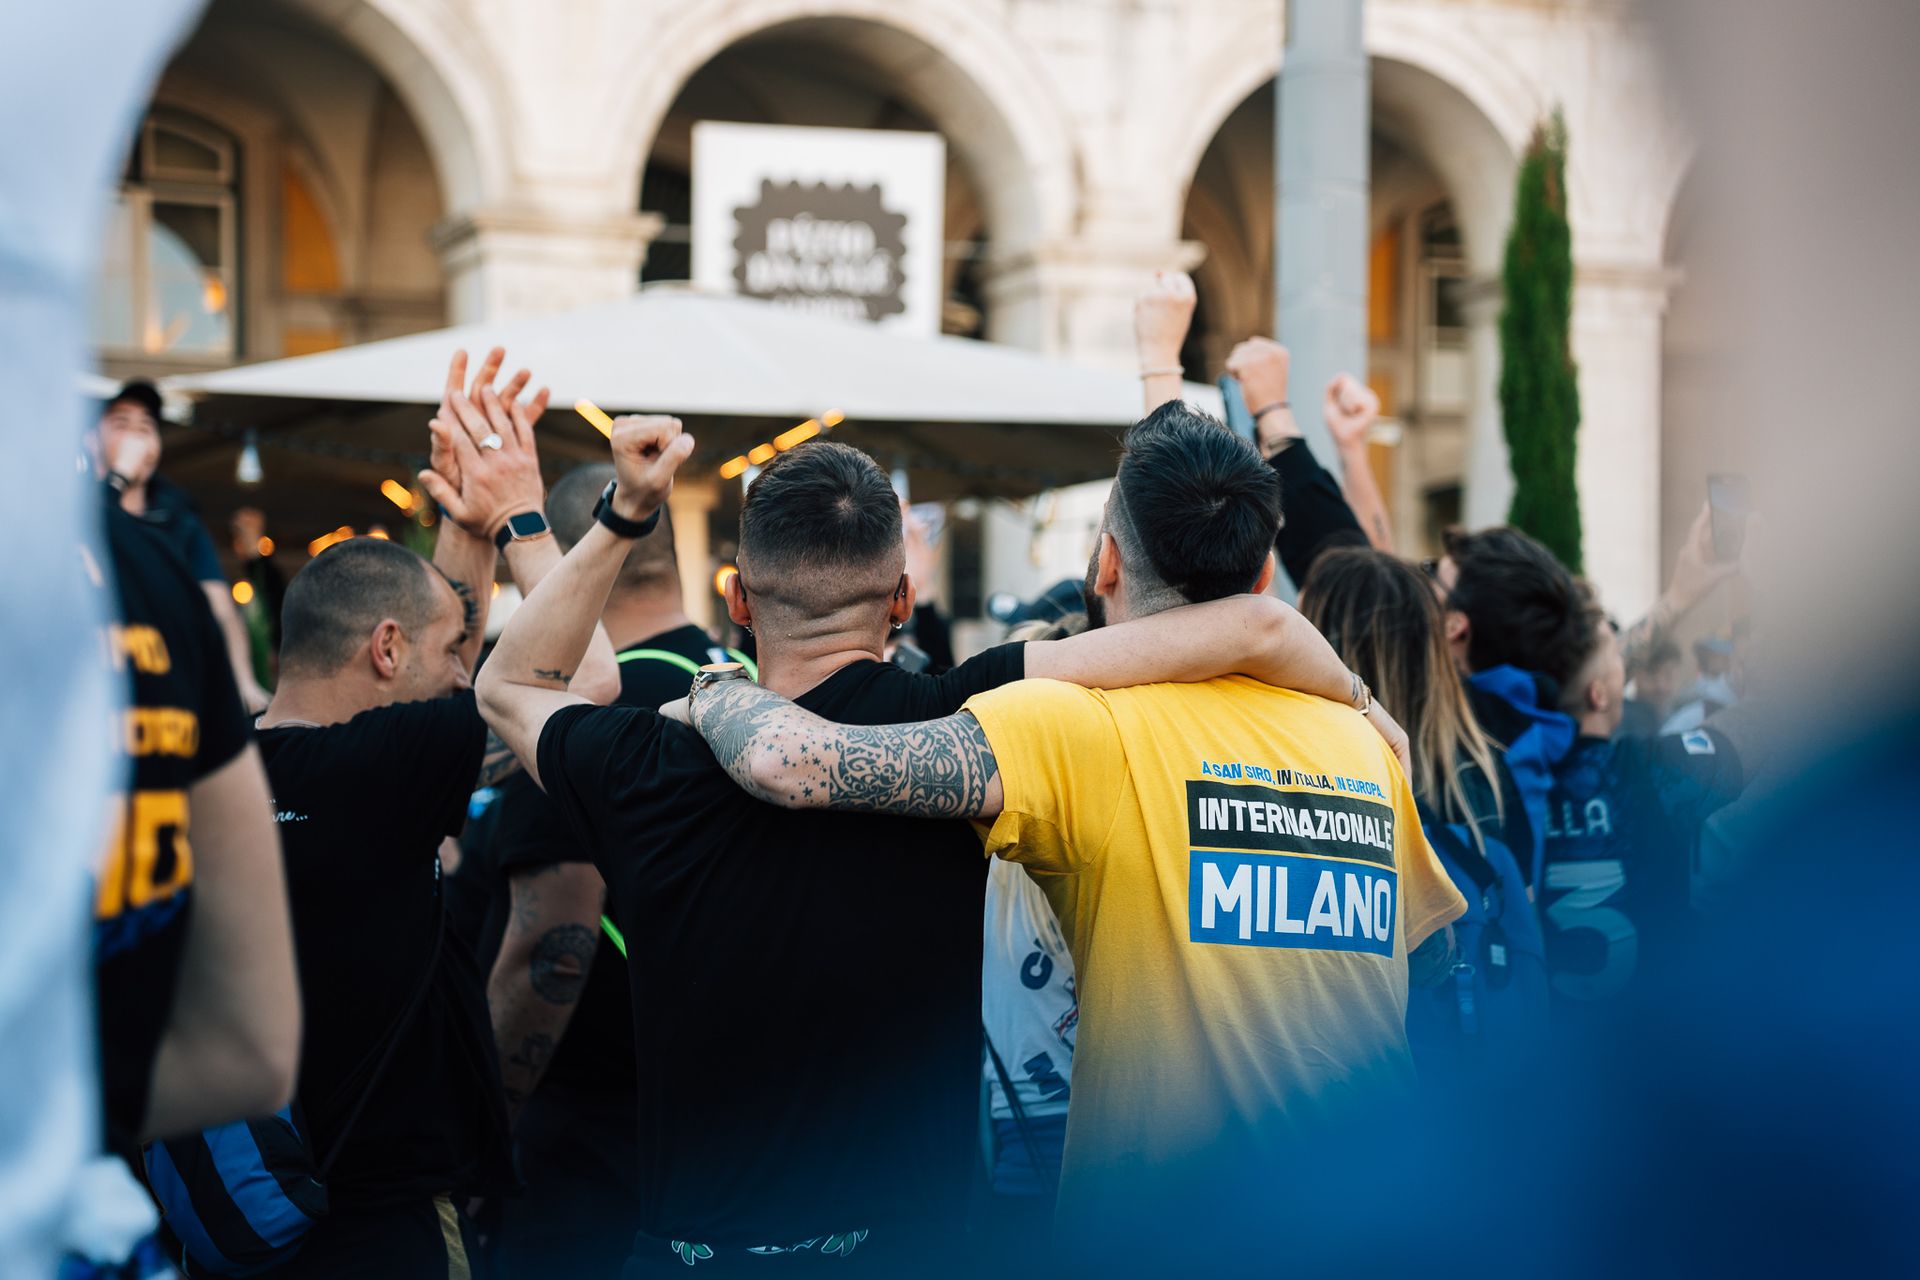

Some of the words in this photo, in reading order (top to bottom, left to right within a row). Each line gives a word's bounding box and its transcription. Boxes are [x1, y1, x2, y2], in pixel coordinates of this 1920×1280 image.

[1202, 760, 1212, 776] A
[1212, 763, 1242, 779] SAN
[1244, 765, 1276, 785] SIRO,
[1277, 769, 1292, 785] IN
[1294, 771, 1335, 791] ITALIA,
[1335, 776, 1347, 792] IN
[1198, 797, 1393, 852] INTERNAZIONALE
[1201, 861, 1393, 943] MILANO
